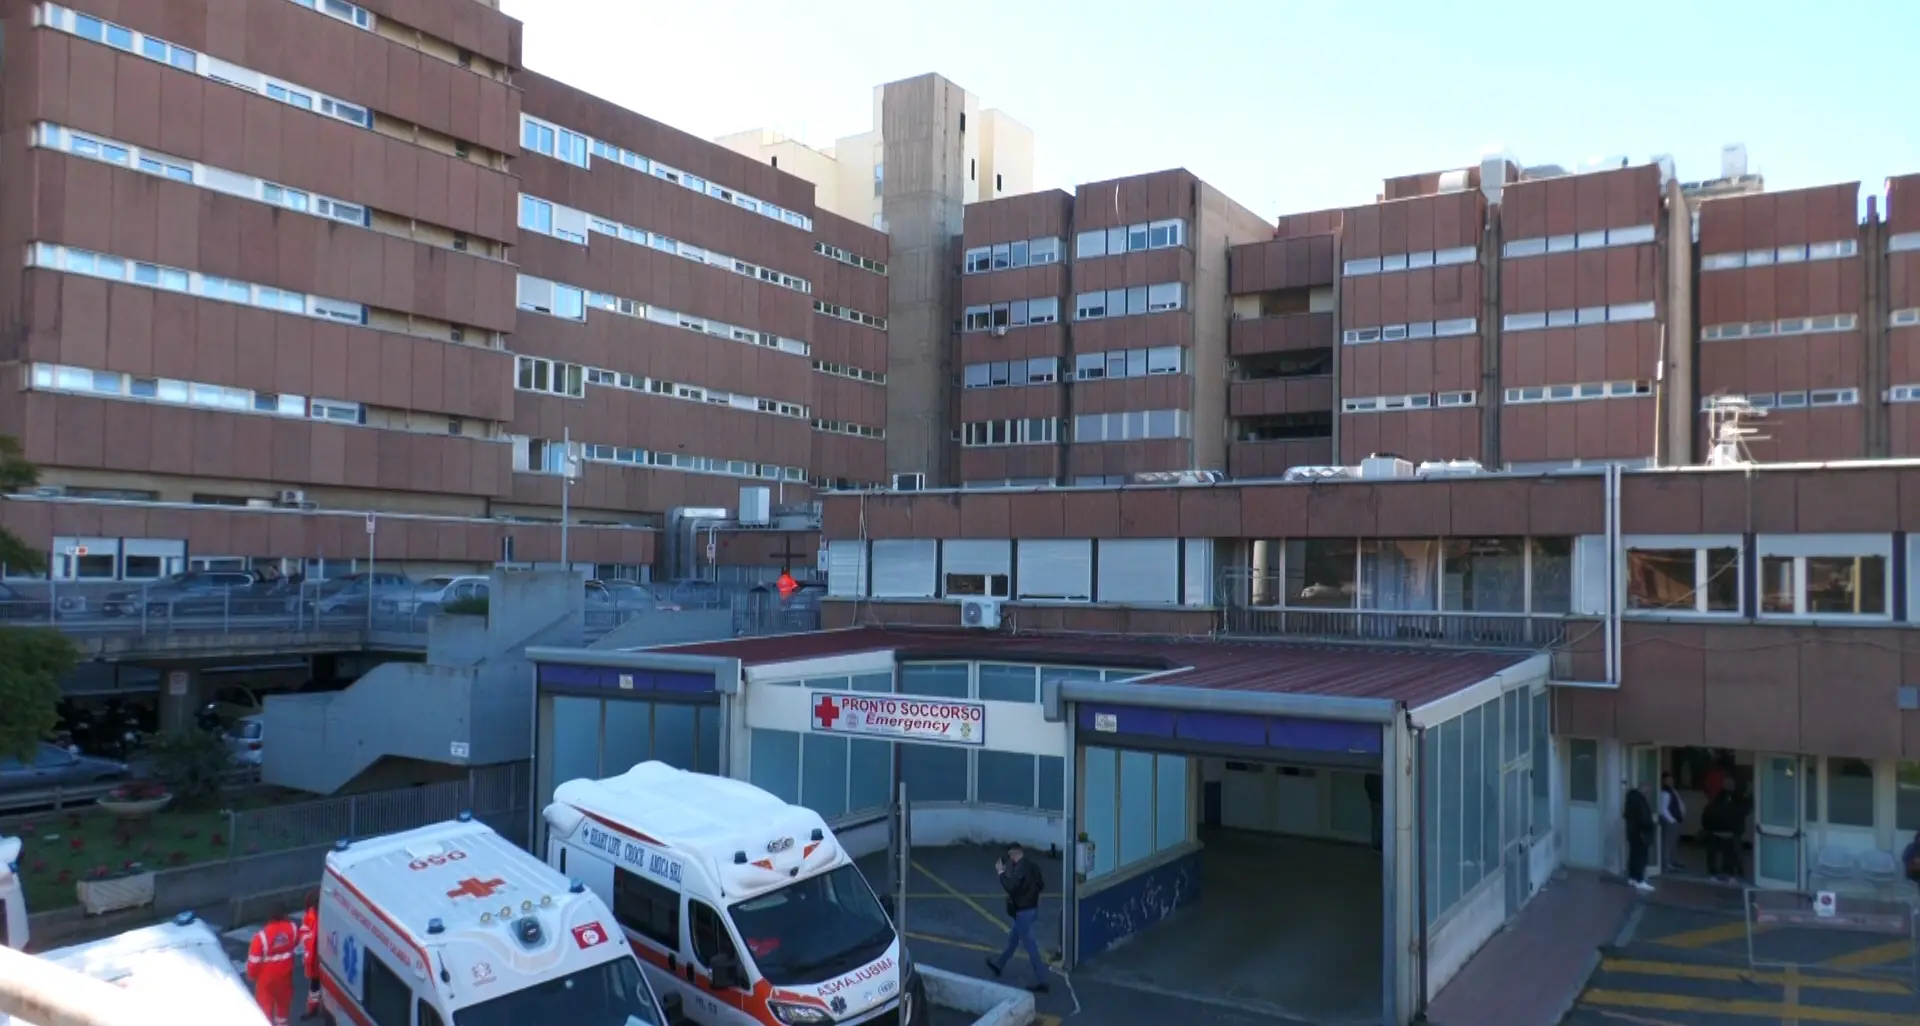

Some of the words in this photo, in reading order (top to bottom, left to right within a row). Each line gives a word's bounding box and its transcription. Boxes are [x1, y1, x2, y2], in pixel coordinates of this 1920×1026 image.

[842, 698, 897, 714] PRONTO
[900, 702, 981, 721] SOCCORSO
[865, 712, 951, 733] Emergency
